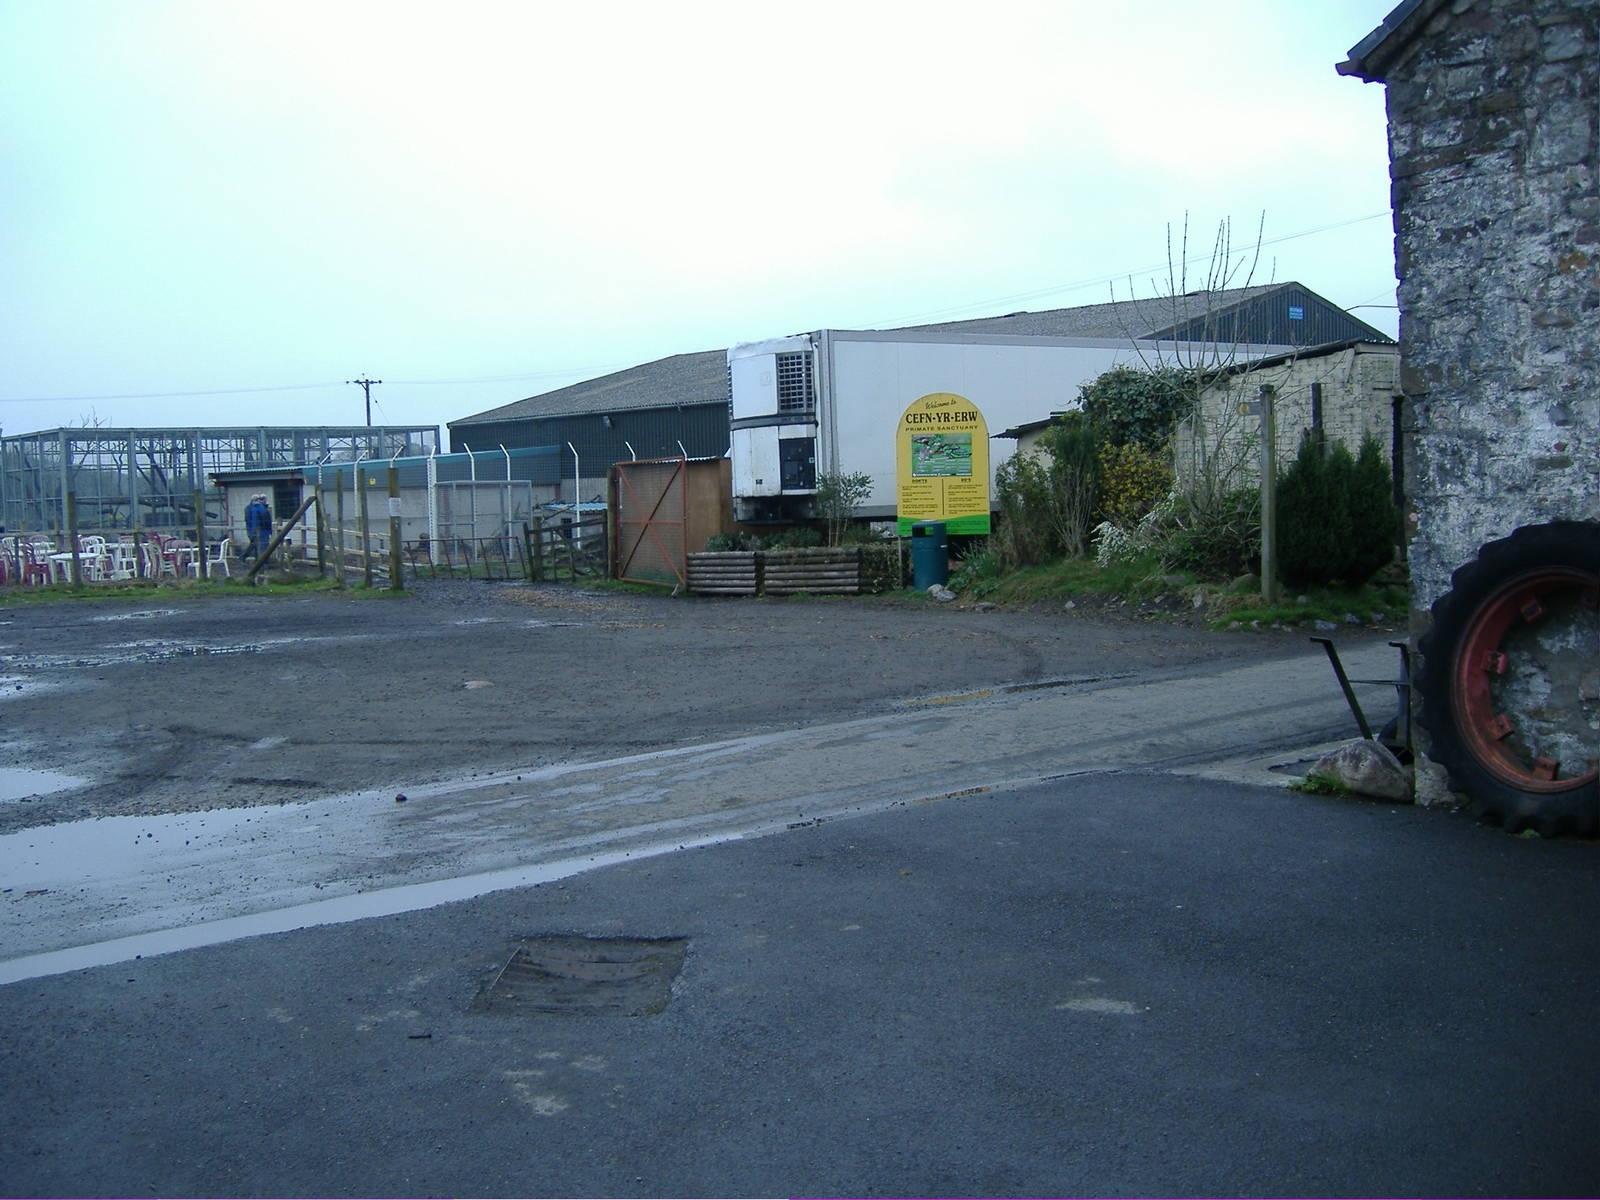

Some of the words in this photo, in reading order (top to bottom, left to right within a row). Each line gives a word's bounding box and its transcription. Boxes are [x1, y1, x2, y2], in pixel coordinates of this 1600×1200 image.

[925, 401, 950, 410] Welcome
[950, 398, 957, 406] to
[905, 411, 978, 424] CEFN-YR-ERW
